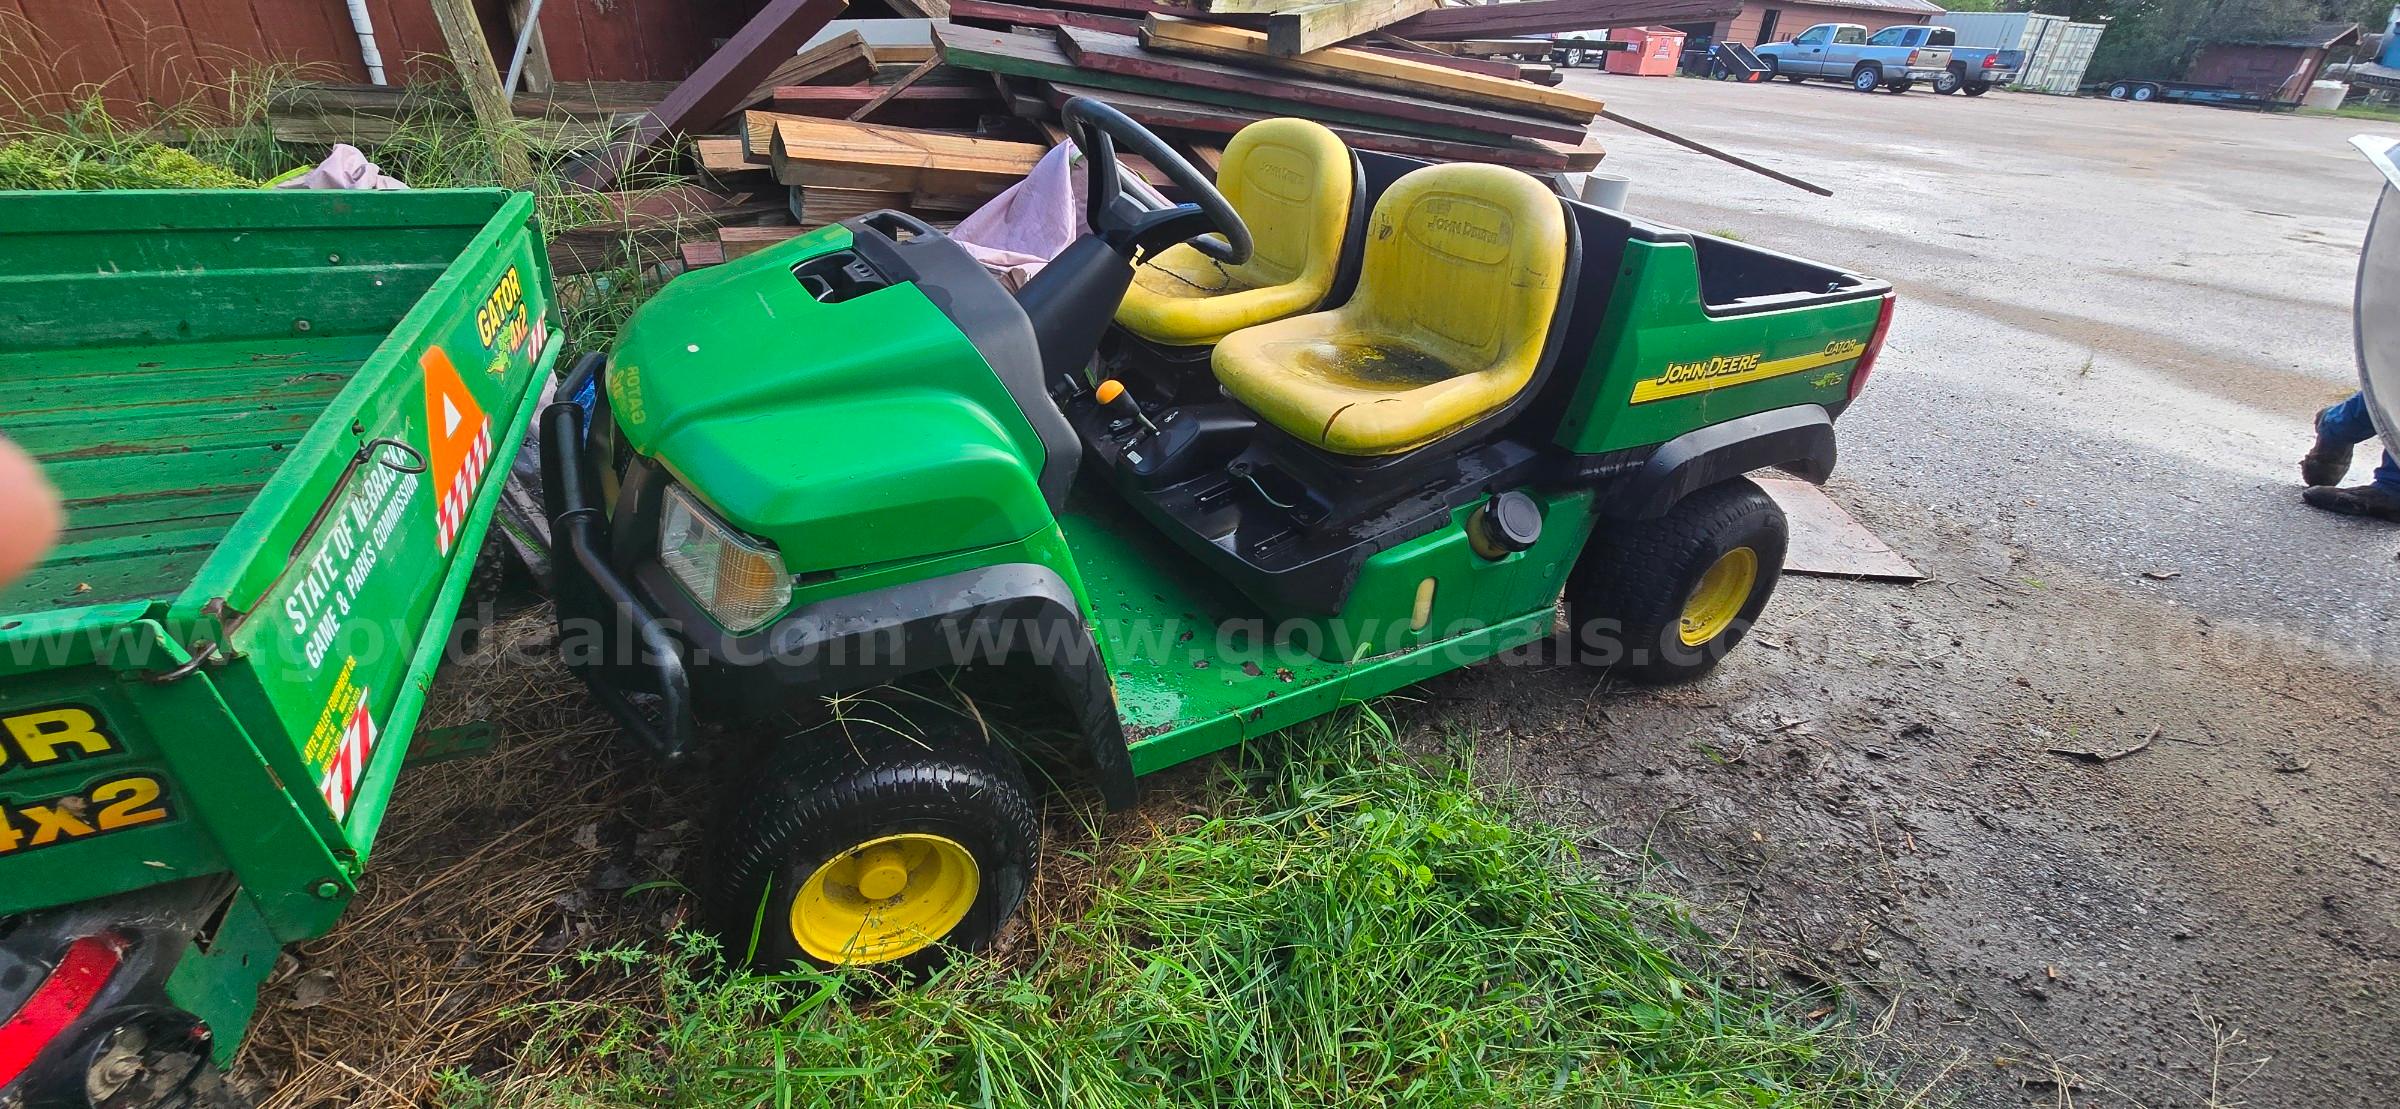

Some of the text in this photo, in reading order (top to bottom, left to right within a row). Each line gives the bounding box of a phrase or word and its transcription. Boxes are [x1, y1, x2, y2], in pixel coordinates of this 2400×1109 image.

[1428, 215, 1462, 235] JOHN
[477, 266, 521, 348] GATOR
[1656, 352, 1761, 385] JOHN DEERE
[1824, 339, 1857, 357] GATOR
[285, 543, 339, 635] STATE
[333, 514, 355, 560] OF
[305, 471, 420, 669] GAME & PARKS COMMISSION
[0, 708, 111, 767] R
[314, 706, 331, 740] VALLEY
